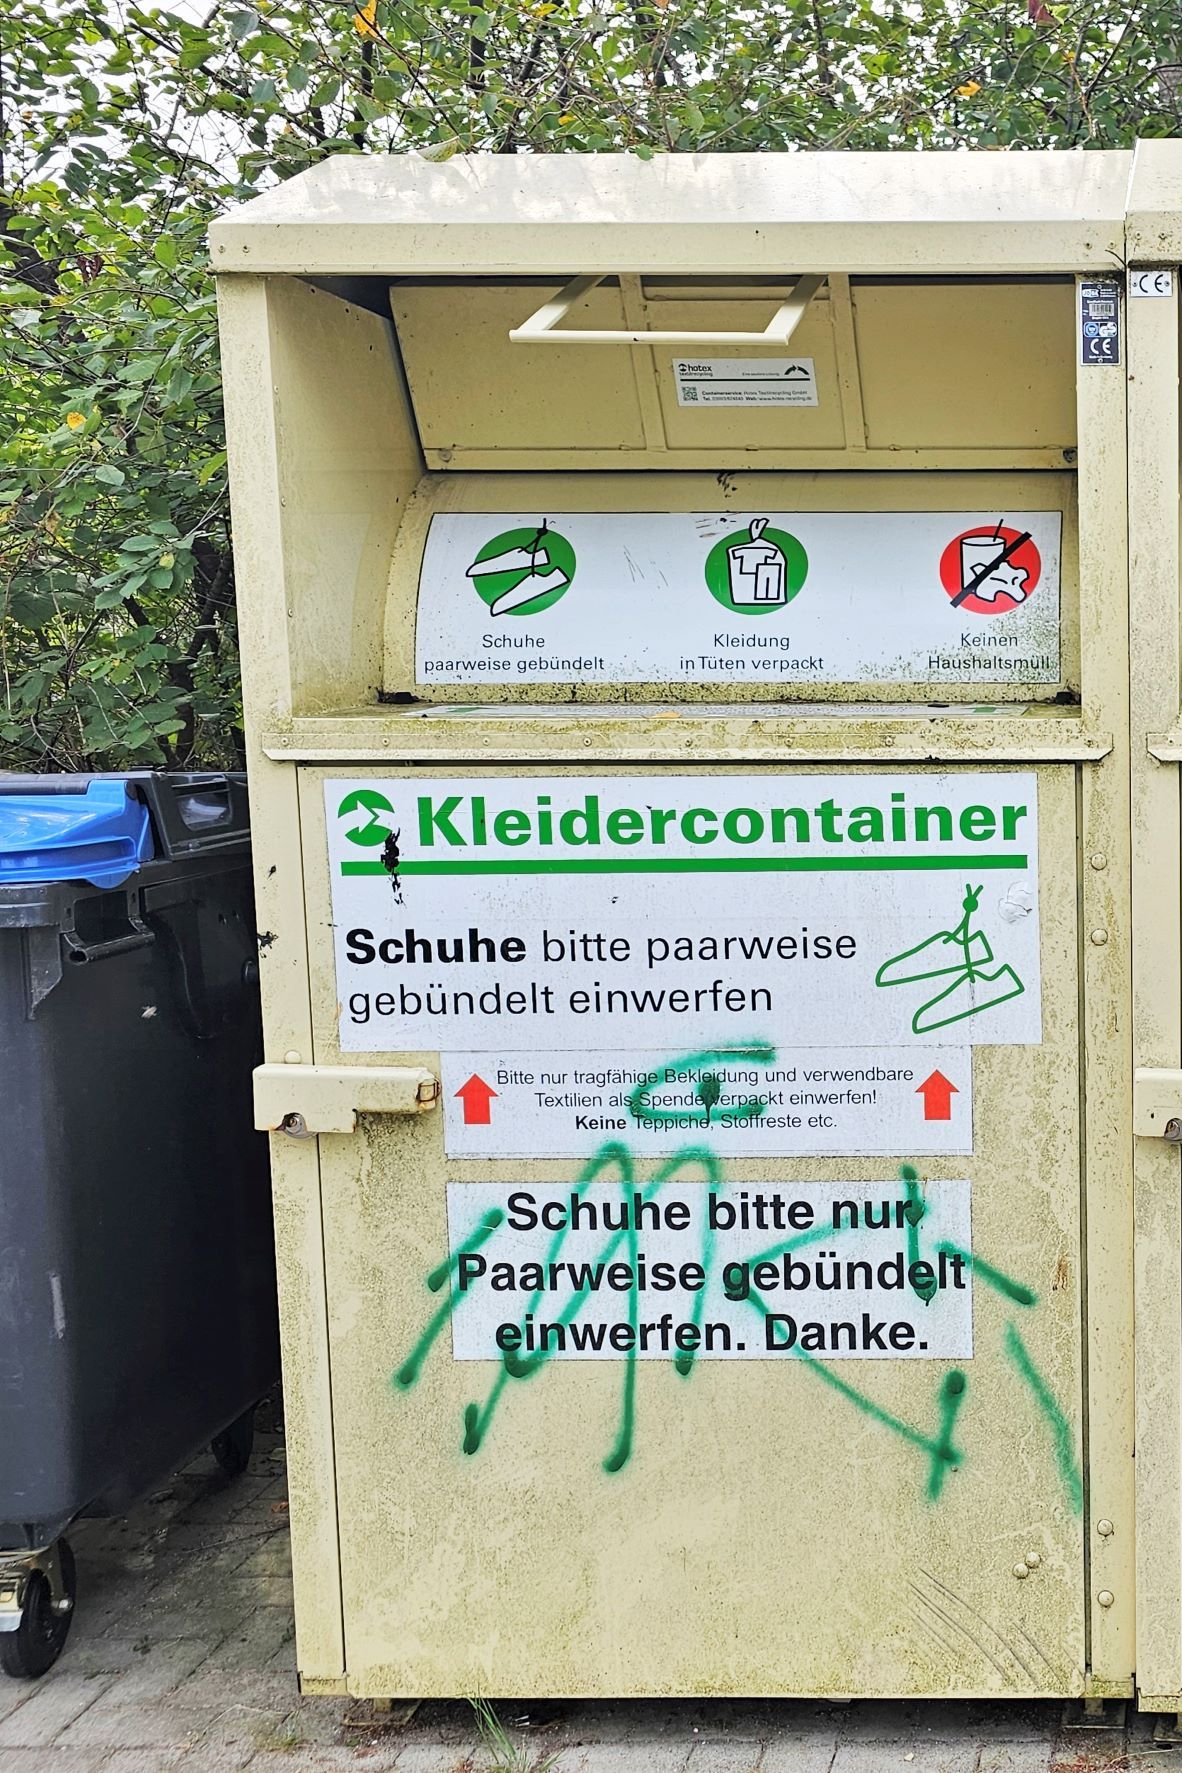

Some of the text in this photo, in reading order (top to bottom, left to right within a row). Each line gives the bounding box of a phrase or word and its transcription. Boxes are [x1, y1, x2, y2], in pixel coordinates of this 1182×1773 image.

[687, 363, 712, 372] hotex
[482, 634, 545, 648] Schuhe
[714, 633, 790, 651] Kleidung
[961, 633, 1018, 647] Keinen
[424, 656, 605, 674] paarweise gebündelt
[680, 655, 824, 673] in Tüten verpackt
[928, 655, 1050, 670] Haushaltsmüll
[417, 792, 1026, 846] Kleidercontainer
[345, 927, 857, 969] Schuhe bitte paarweise
[349, 979, 772, 1024] gebündelt einwerfen
[497, 1066, 914, 1088] Bitte nur tragfähige Bekleidung und verwendbare
[534, 1089, 876, 1109] Textilien als Spende verpackt einwerfen!
[575, 1112, 837, 1132] Keine Teppiche, Stoffreste etc.
[507, 1191, 912, 1231] Schuhe bitte nur
[458, 1251, 966, 1300] Paarweise gebündelt
[495, 1313, 928, 1352] einwerfen. Danke.
